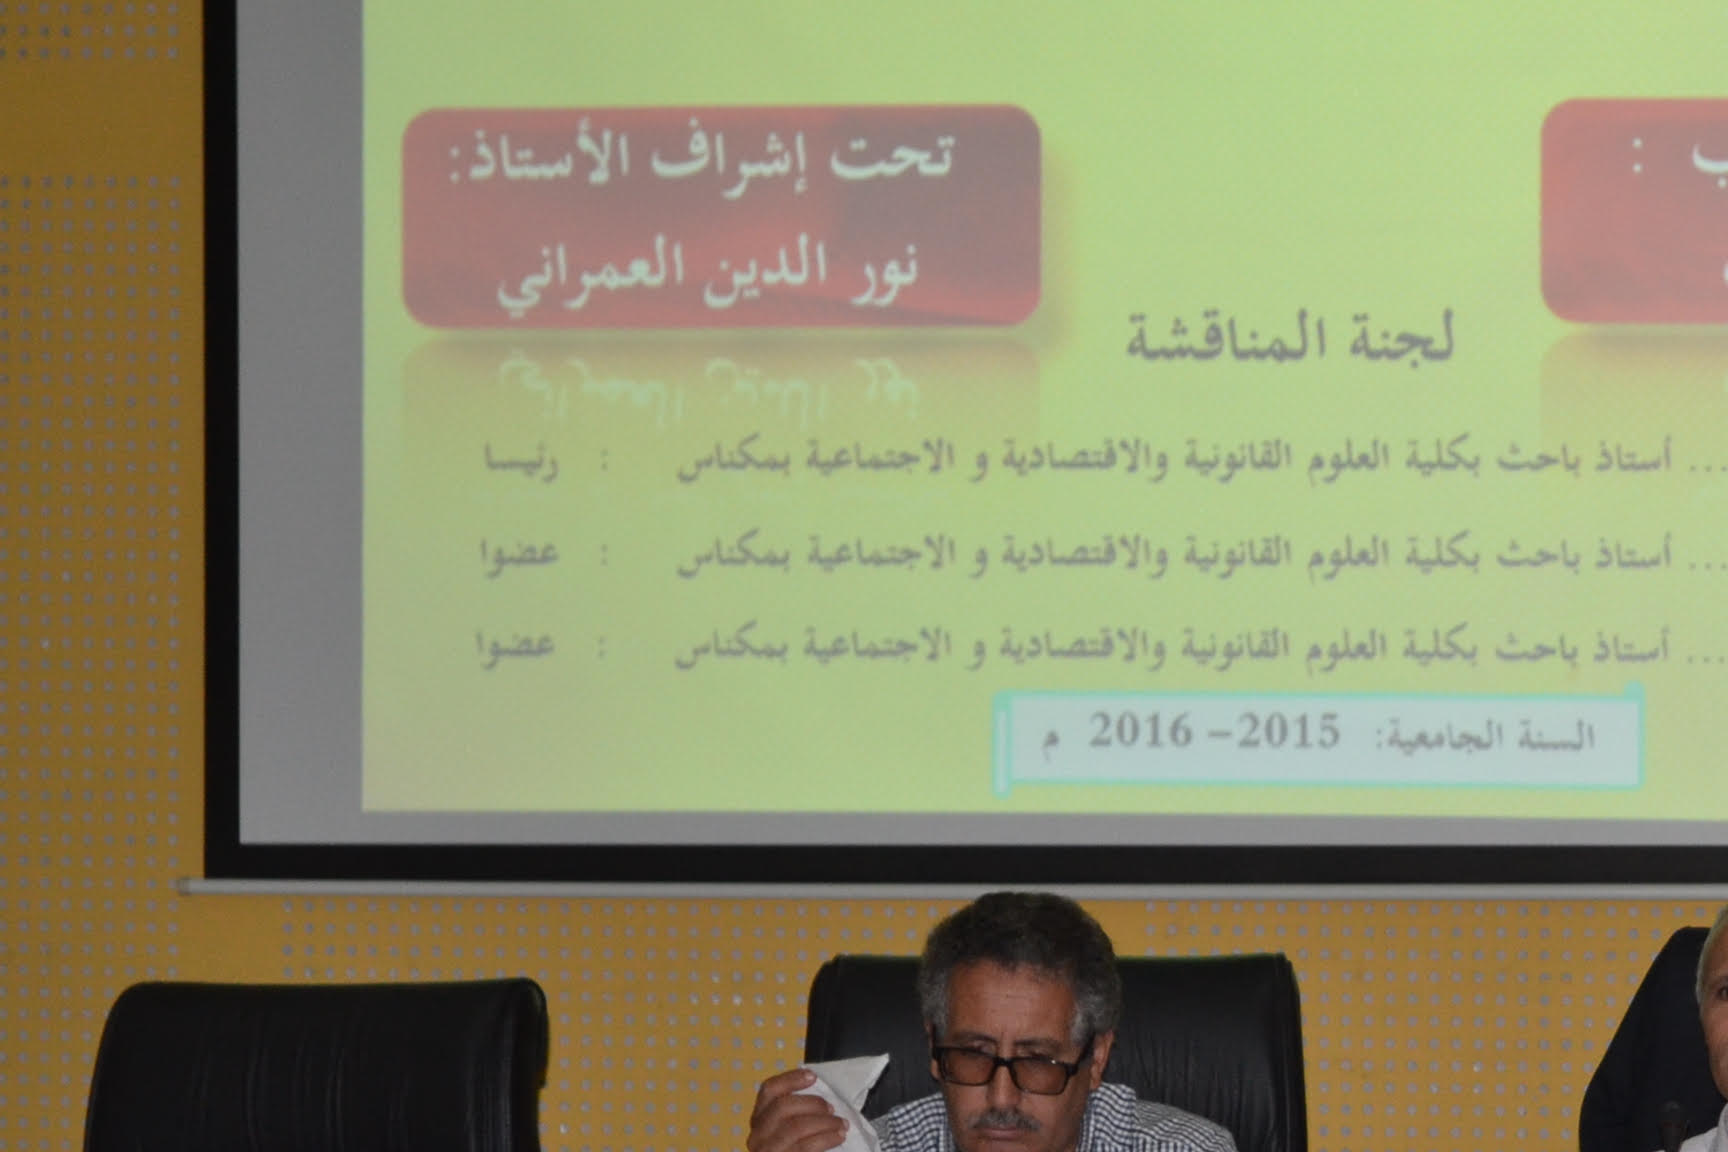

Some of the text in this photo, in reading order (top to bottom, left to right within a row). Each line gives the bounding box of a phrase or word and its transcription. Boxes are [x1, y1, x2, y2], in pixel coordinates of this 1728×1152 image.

[651, 131, 806, 199] إشراف
[830, 136, 955, 180] تحت
[497, 232, 918, 315] نور الدين العمراني
[1126, 307, 1454, 369] لجنة المناقشة
[484, 443, 559, 484] رئيسا
[676, 432, 792, 485] بمكناس
[805, 437, 955, 477] الاجتماعية
[970, 451, 989, 484] و
[1002, 437, 1169, 484] والاقتصادية
[1184, 438, 1292, 484] القانونية
[1308, 438, 1390, 484] العلوم
[1405, 432, 1481, 477] بكلية
[1496, 443, 1581, 477] باحث
[1594, 435, 1672, 473] أستاذ
[480, 539, 559, 580] عضوا
[676, 527, 791, 580] بمكناس
[807, 533, 956, 573] الاجتماعية
[970, 547, 989, 580] و
[1001, 533, 1169, 580] والاقتصادية
[1183, 534, 1292, 580] القانونية
[1307, 535, 1389, 581] العلوم
[1404, 529, 1481, 575] بكلية
[1496, 539, 1581, 575] باحث
[1595, 532, 1672, 570] أستاذ
[475, 632, 555, 671] عضوا
[674, 619, 789, 671] بمكناس
[803, 626, 952, 665] الاجتماعية
[968, 639, 987, 672] و
[999, 627, 1167, 672] والاقتصادية
[1181, 627, 1290, 673] القانونية
[1305, 628, 1387, 673] العلوم
[1402, 621, 1478, 667] بكلية
[1495, 633, 1579, 669] باحث
[1593, 626, 1670, 664] أستاذ
[1517, 719, 1595, 752] السنة
